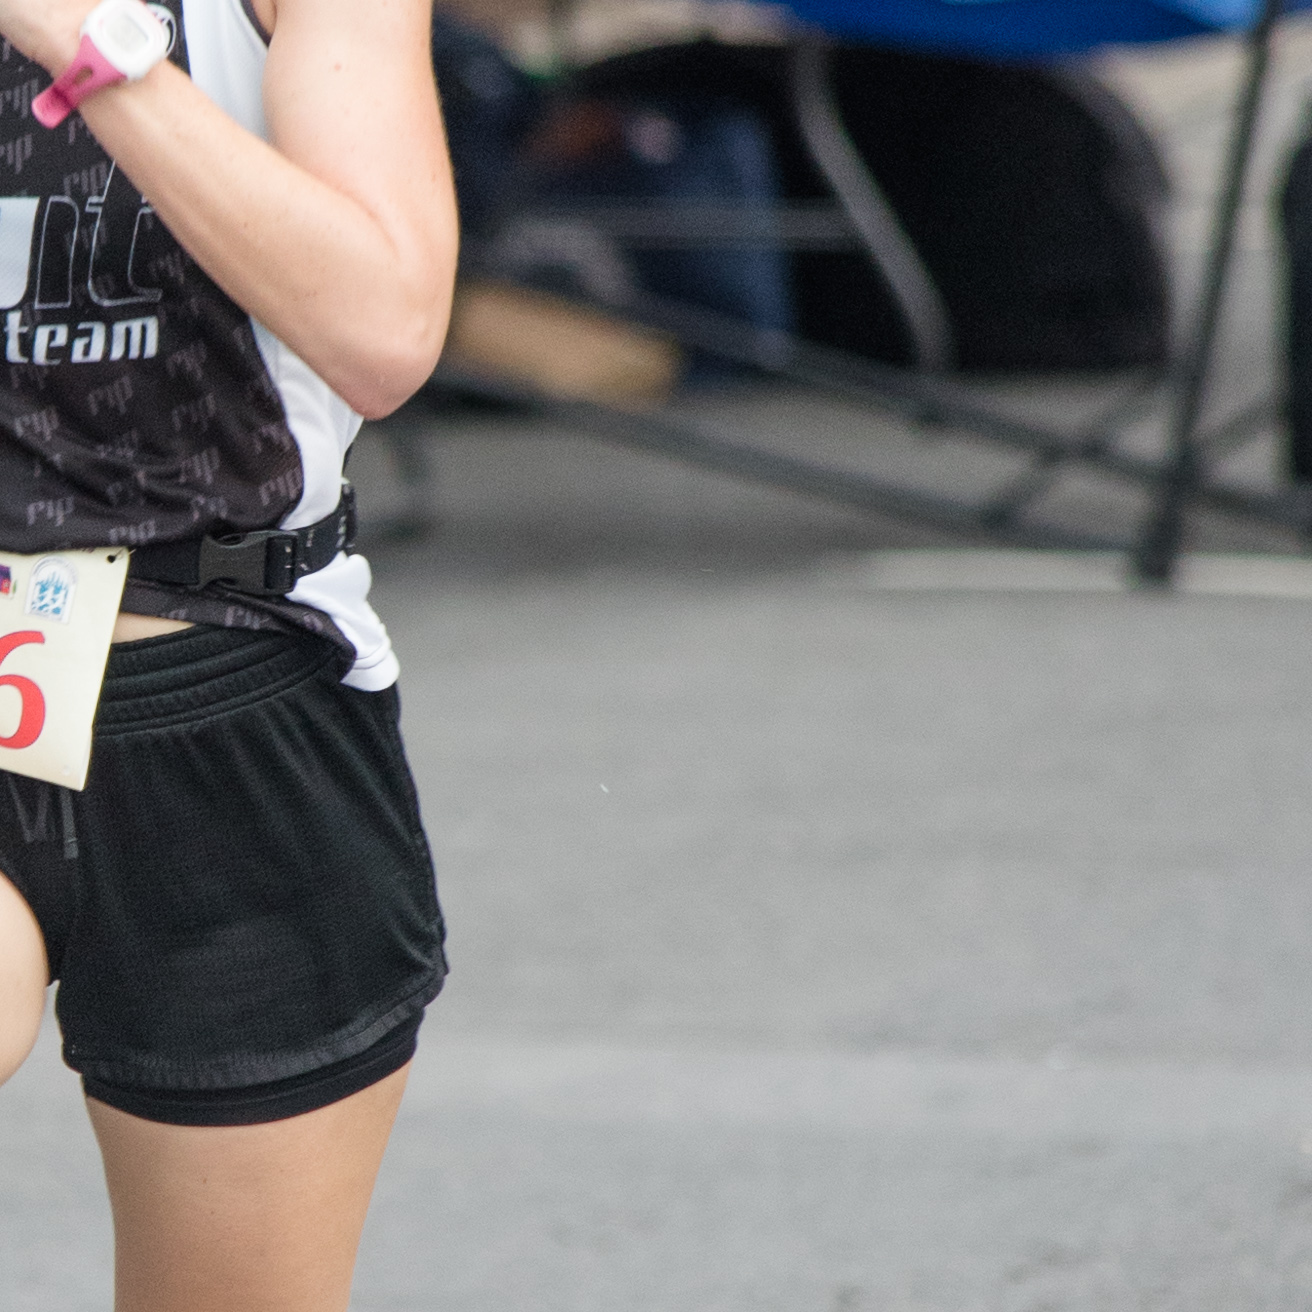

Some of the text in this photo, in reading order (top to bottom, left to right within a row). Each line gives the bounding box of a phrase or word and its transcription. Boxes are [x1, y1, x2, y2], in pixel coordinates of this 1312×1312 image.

[63, 161, 108, 197] rip
[4, 310, 160, 366] team
[88, 375, 134, 416] rip
[14, 405, 60, 443] rip
[26, 495, 75, 527] rip
